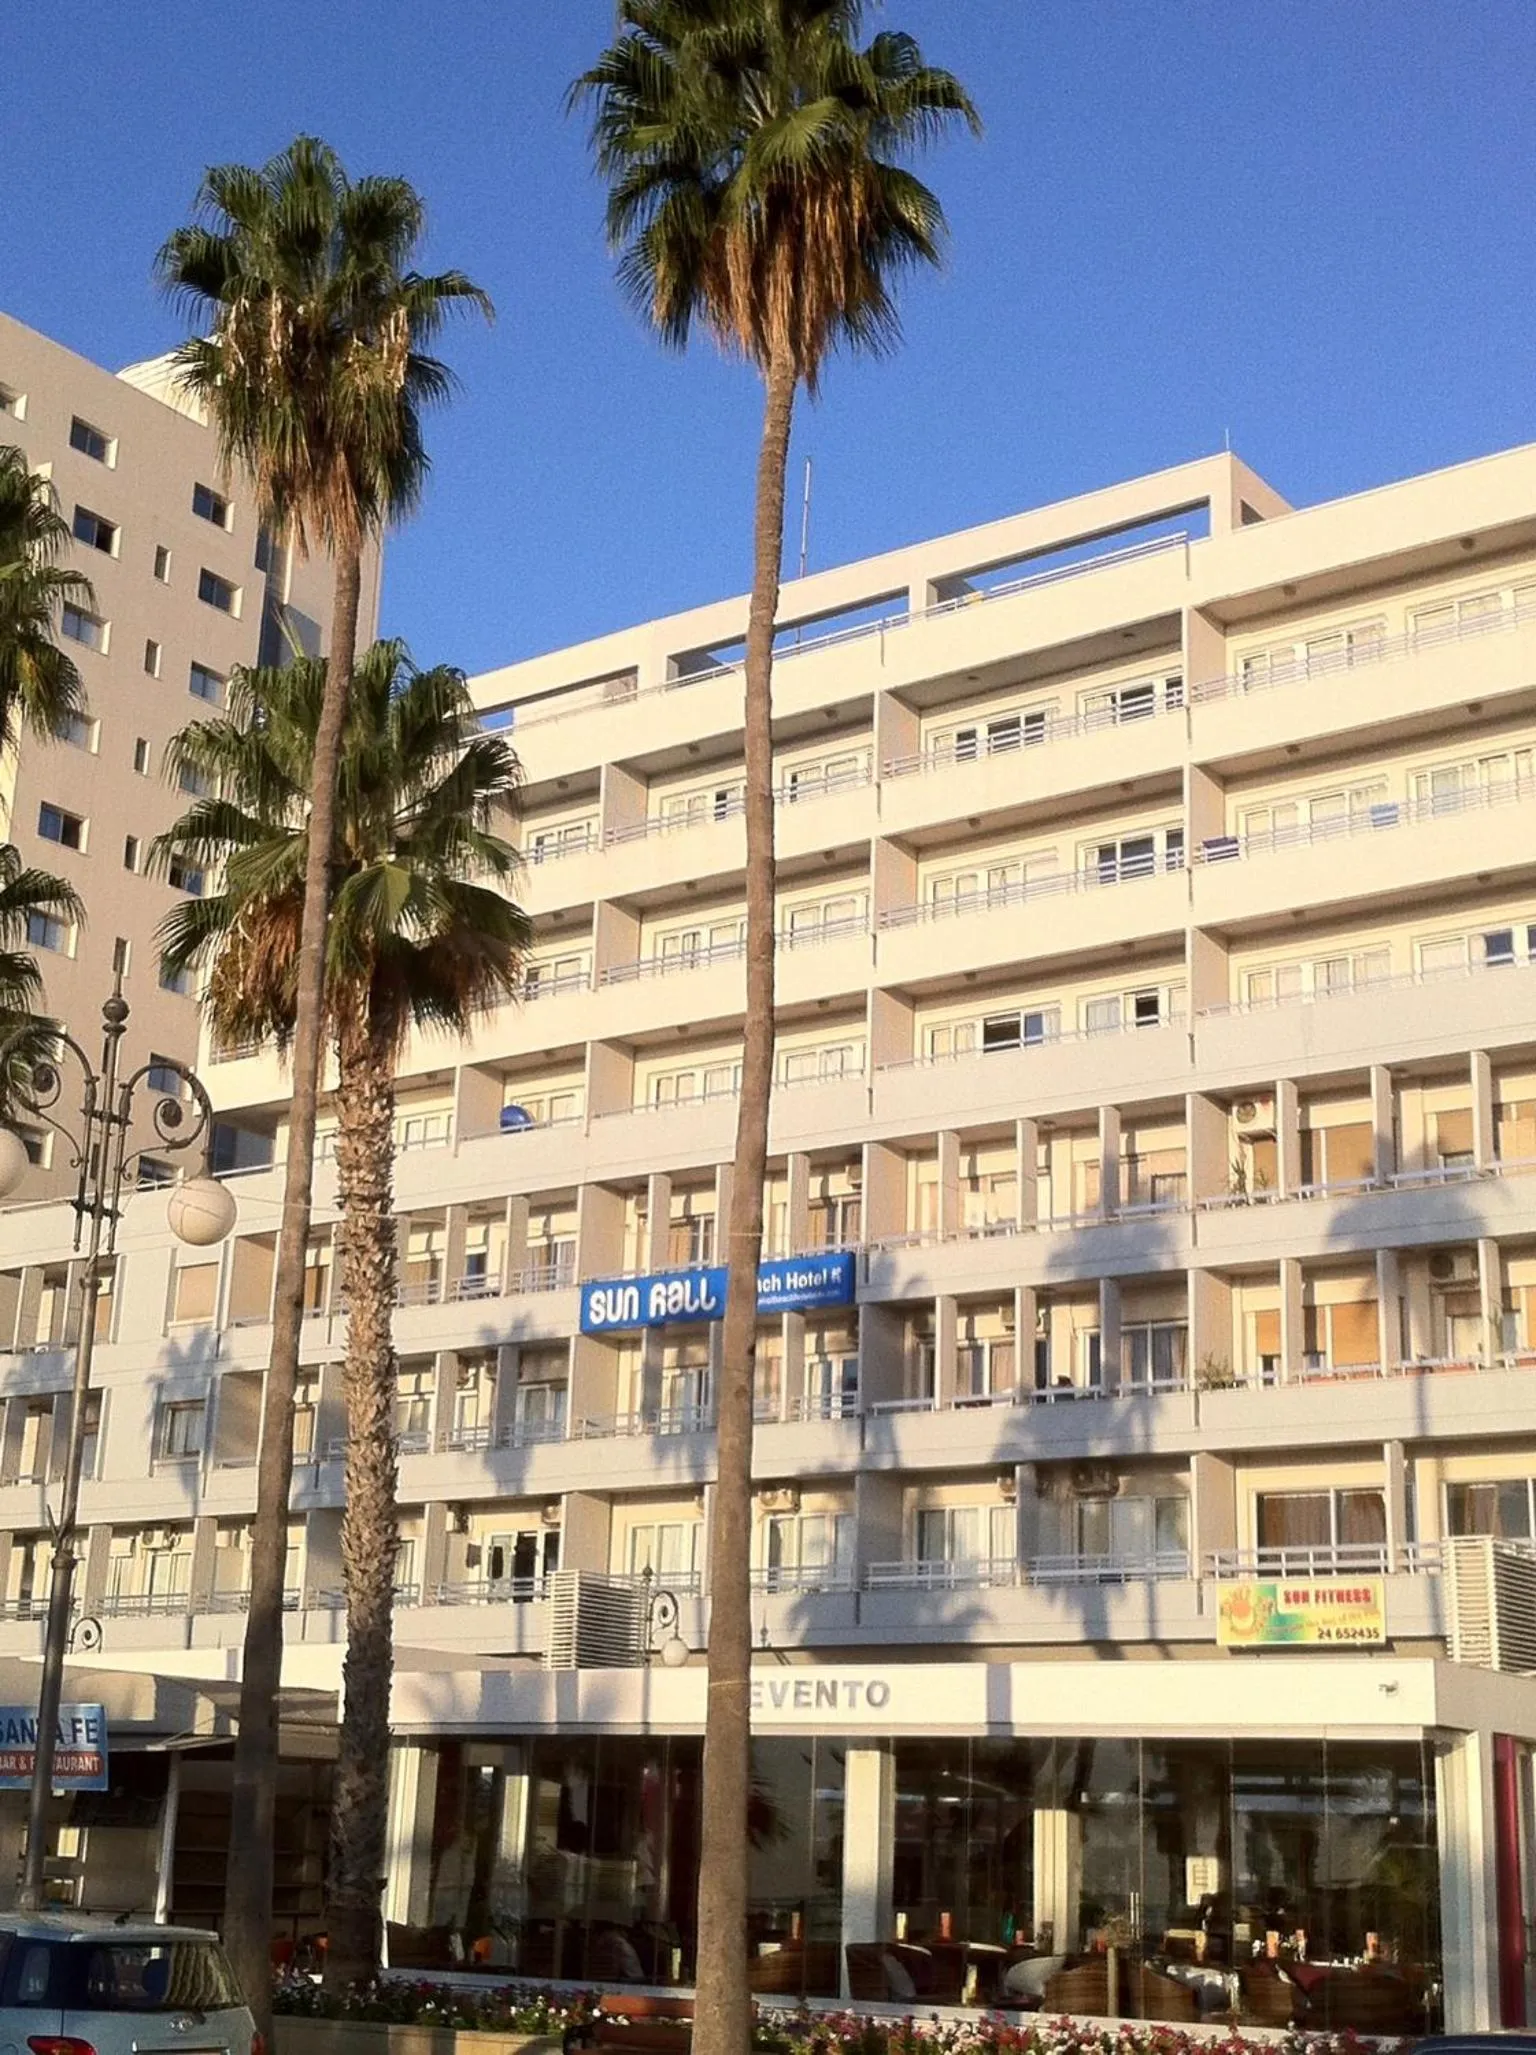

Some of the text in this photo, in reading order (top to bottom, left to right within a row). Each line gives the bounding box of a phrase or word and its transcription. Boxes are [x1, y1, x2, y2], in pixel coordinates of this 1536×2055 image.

[786, 1268, 827, 1290] Hotel
[1283, 1588, 1371, 1605] SUN FITNESS
[1317, 1626, 1380, 1640] 24 652435
[71, 1717, 99, 1744] FE
[18, 1755, 27, 1770] &
